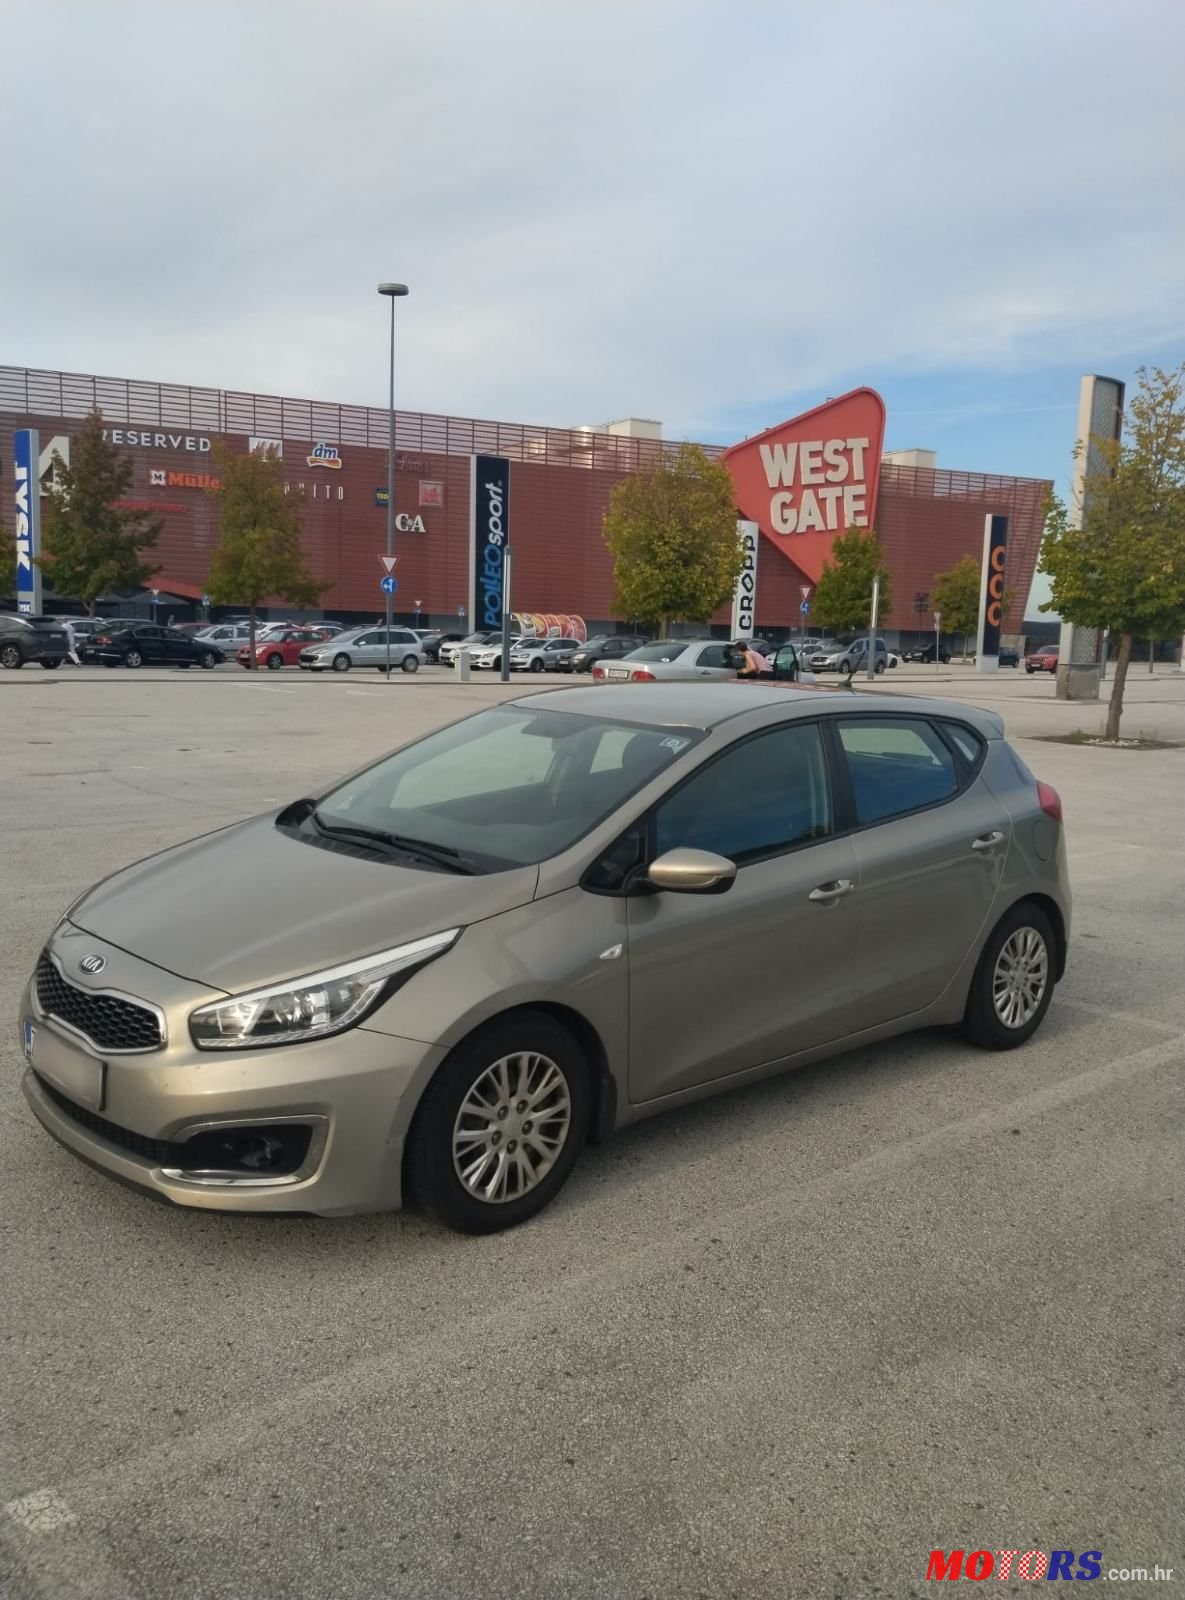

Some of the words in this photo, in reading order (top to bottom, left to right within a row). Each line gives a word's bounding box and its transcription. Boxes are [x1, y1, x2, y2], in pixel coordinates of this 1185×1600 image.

[314, 444, 337, 459] dm
[759, 437, 870, 488] WEST
[168, 471, 221, 489] Mülle
[15, 461, 31, 571] JYSK
[770, 484, 869, 535] GATE
[738, 535, 756, 631] CROPP
[987, 545, 1006, 627] CCC
[81, 956, 102, 971] KIA
